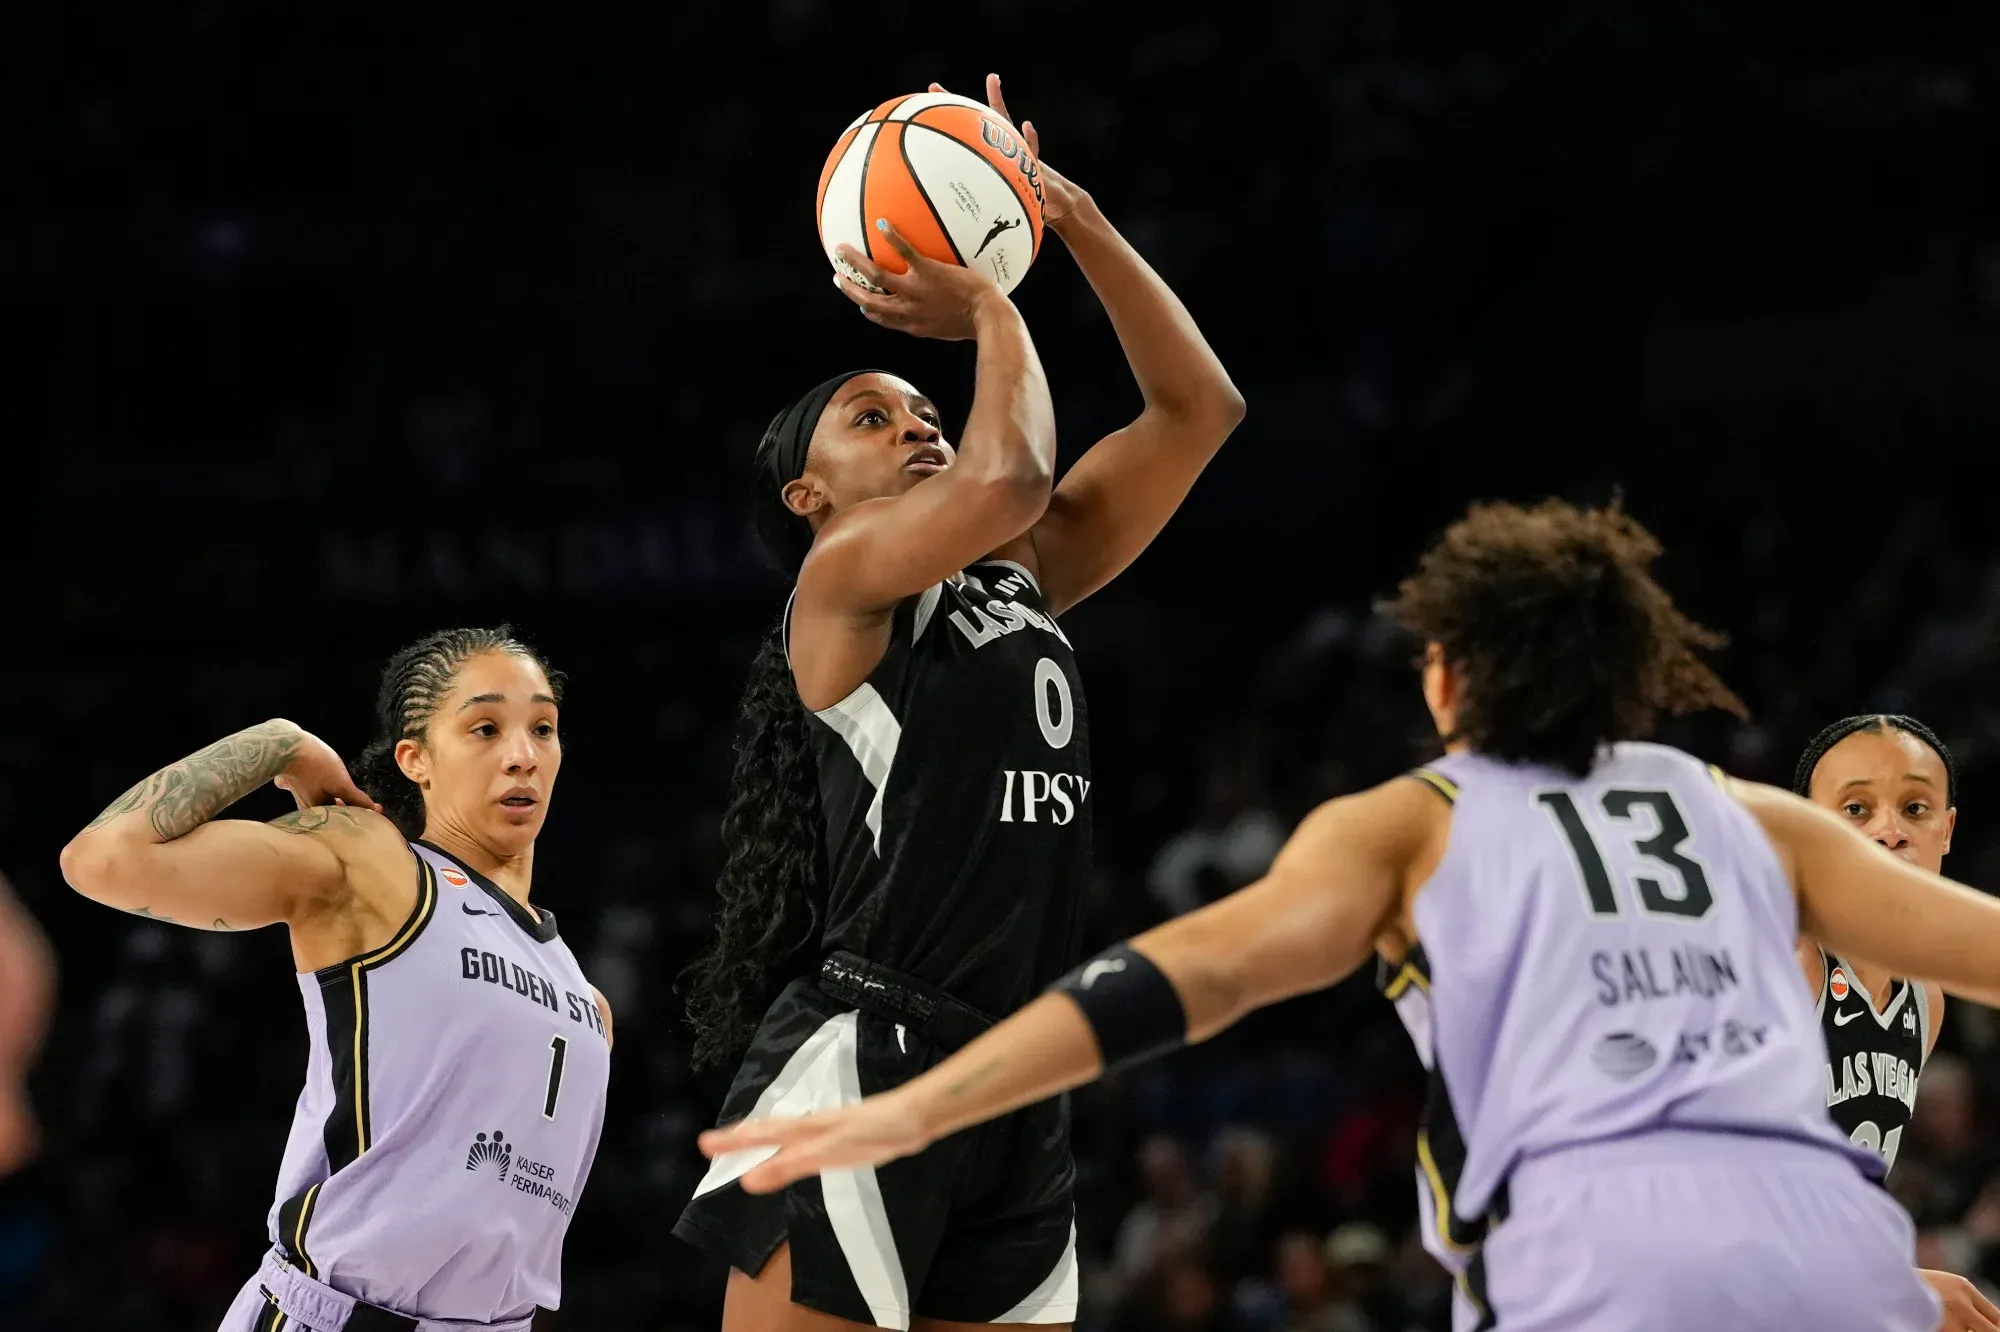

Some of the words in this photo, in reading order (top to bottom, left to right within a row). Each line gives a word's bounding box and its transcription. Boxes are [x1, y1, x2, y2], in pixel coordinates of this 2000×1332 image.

[948, 181, 968, 204] GAME
[965, 203, 980, 224] BALL
[958, 182, 982, 213] OFFICIAL
[994, 571, 1030, 598] lly
[948, 599, 1026, 650] LAS
[1034, 656, 1074, 749] 0
[1532, 785, 1717, 923] 13
[460, 946, 560, 1013] GOLDEN
[541, 1032, 570, 1123] 1
[1825, 1051, 1872, 1108] LAS
[515, 1154, 556, 1182] KAISER
